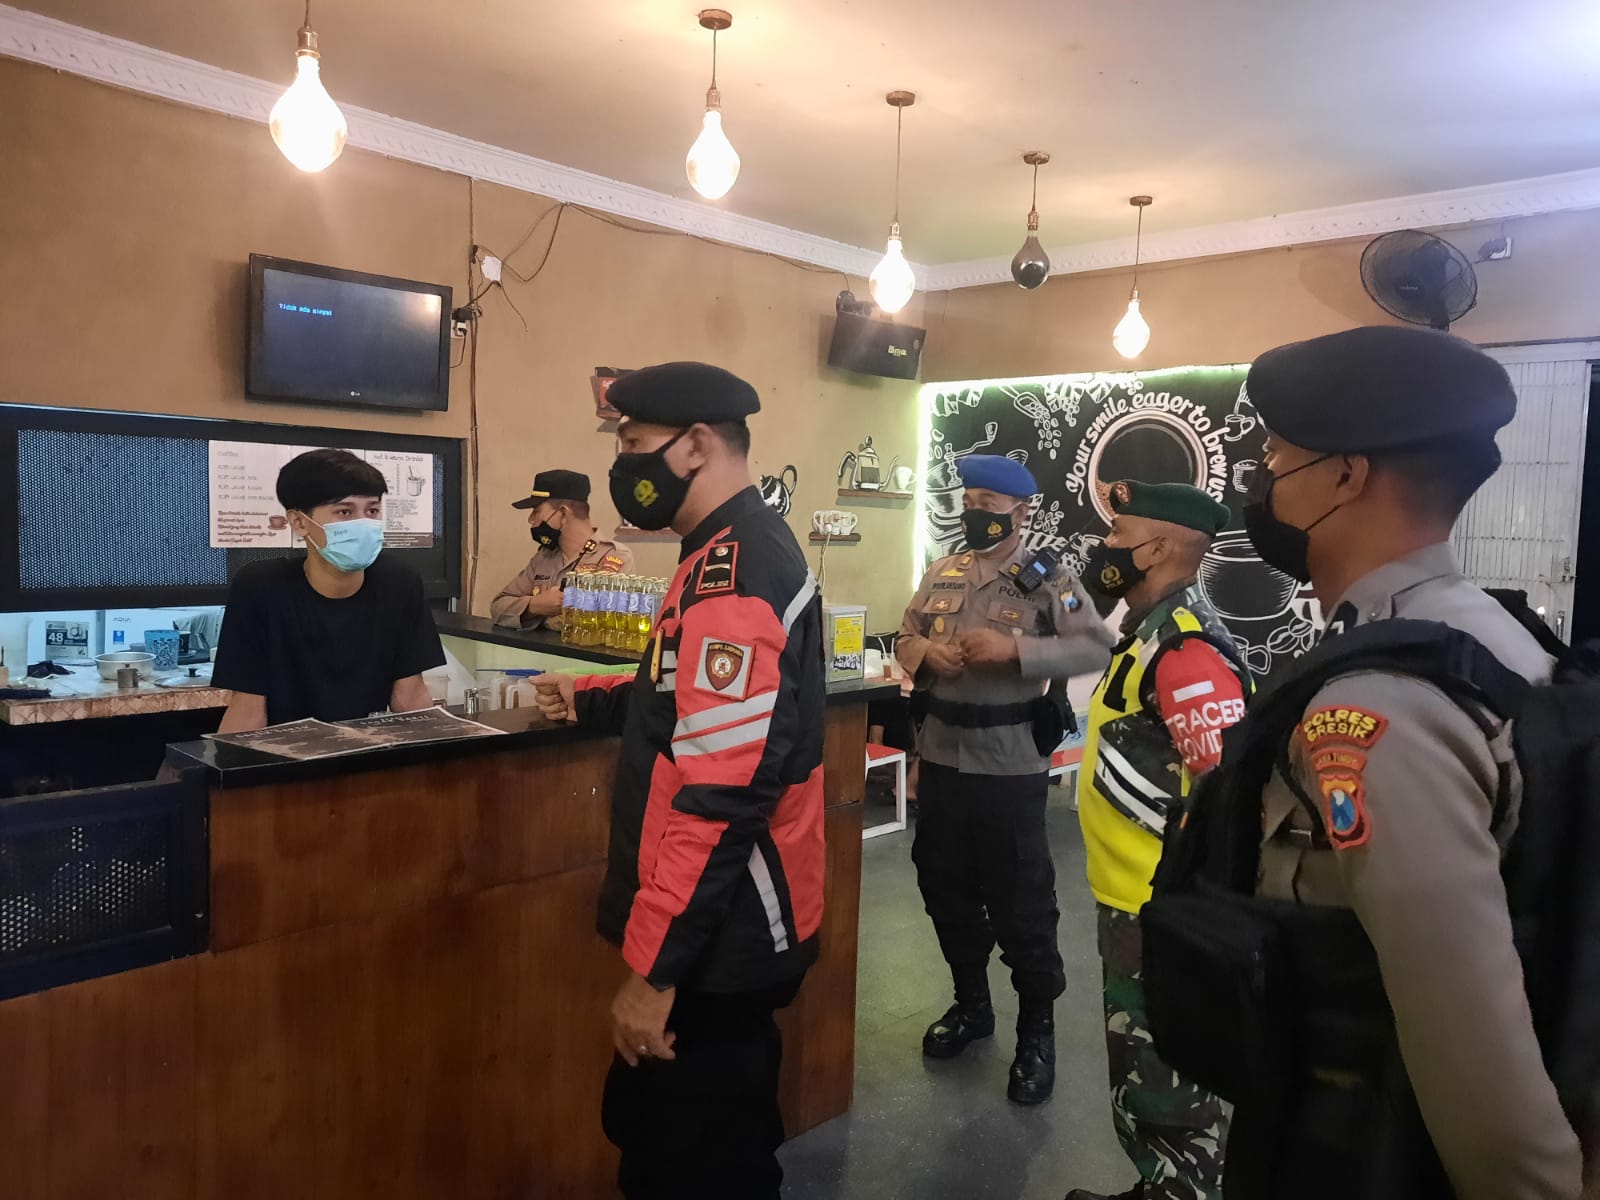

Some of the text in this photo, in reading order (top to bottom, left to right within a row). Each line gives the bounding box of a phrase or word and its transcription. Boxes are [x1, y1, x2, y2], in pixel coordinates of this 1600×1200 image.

[1065, 391, 1231, 506] Your smile eager to brew us
[48, 632, 64, 642] 48
[1303, 709, 1376, 732] POLRES
[1307, 722, 1368, 742] GRESIK
